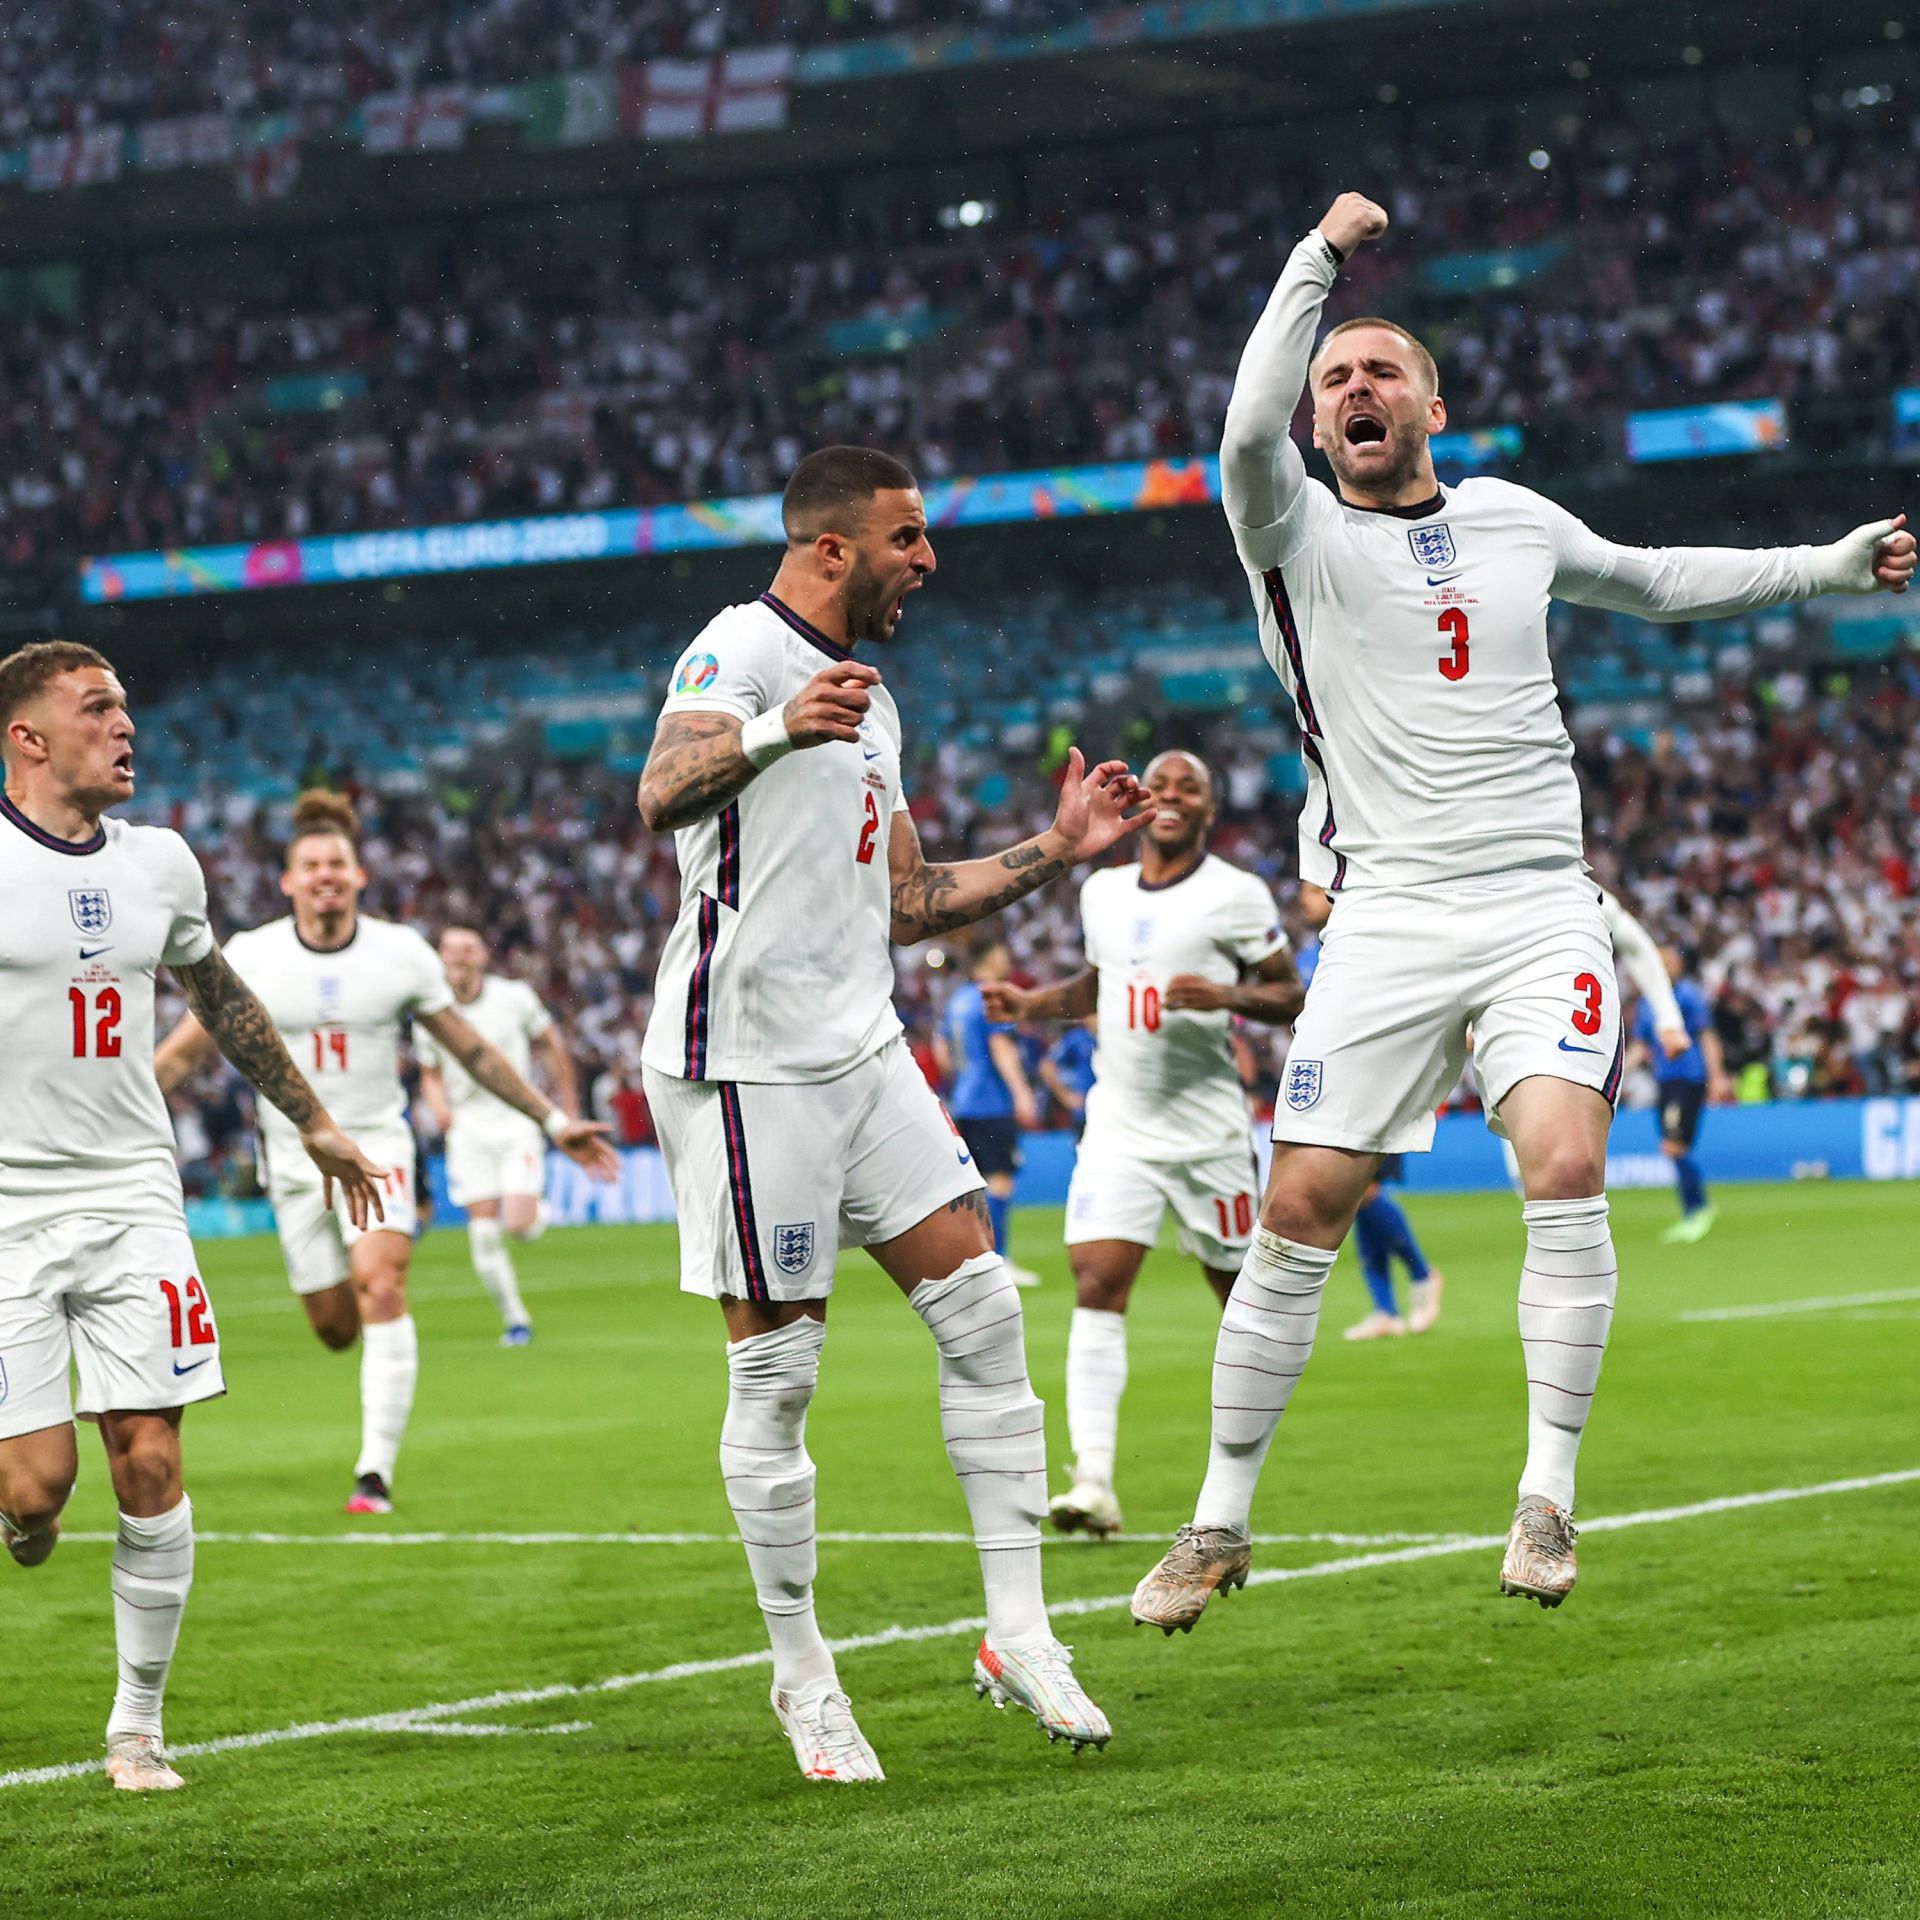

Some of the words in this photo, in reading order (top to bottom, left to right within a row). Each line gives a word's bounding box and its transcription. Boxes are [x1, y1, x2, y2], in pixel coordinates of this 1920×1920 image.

[333, 533, 417, 577] UEFA
[424, 523, 517, 570] EURO
[1437, 607, 1470, 681] 3
[855, 790, 879, 865] 2
[68, 986, 122, 1058] 12
[1127, 985, 1161, 1033] 10
[1571, 972, 1603, 1036] 3
[311, 1028, 346, 1072] 14
[1215, 1191, 1251, 1238] 10
[159, 1275, 216, 1348] 12
